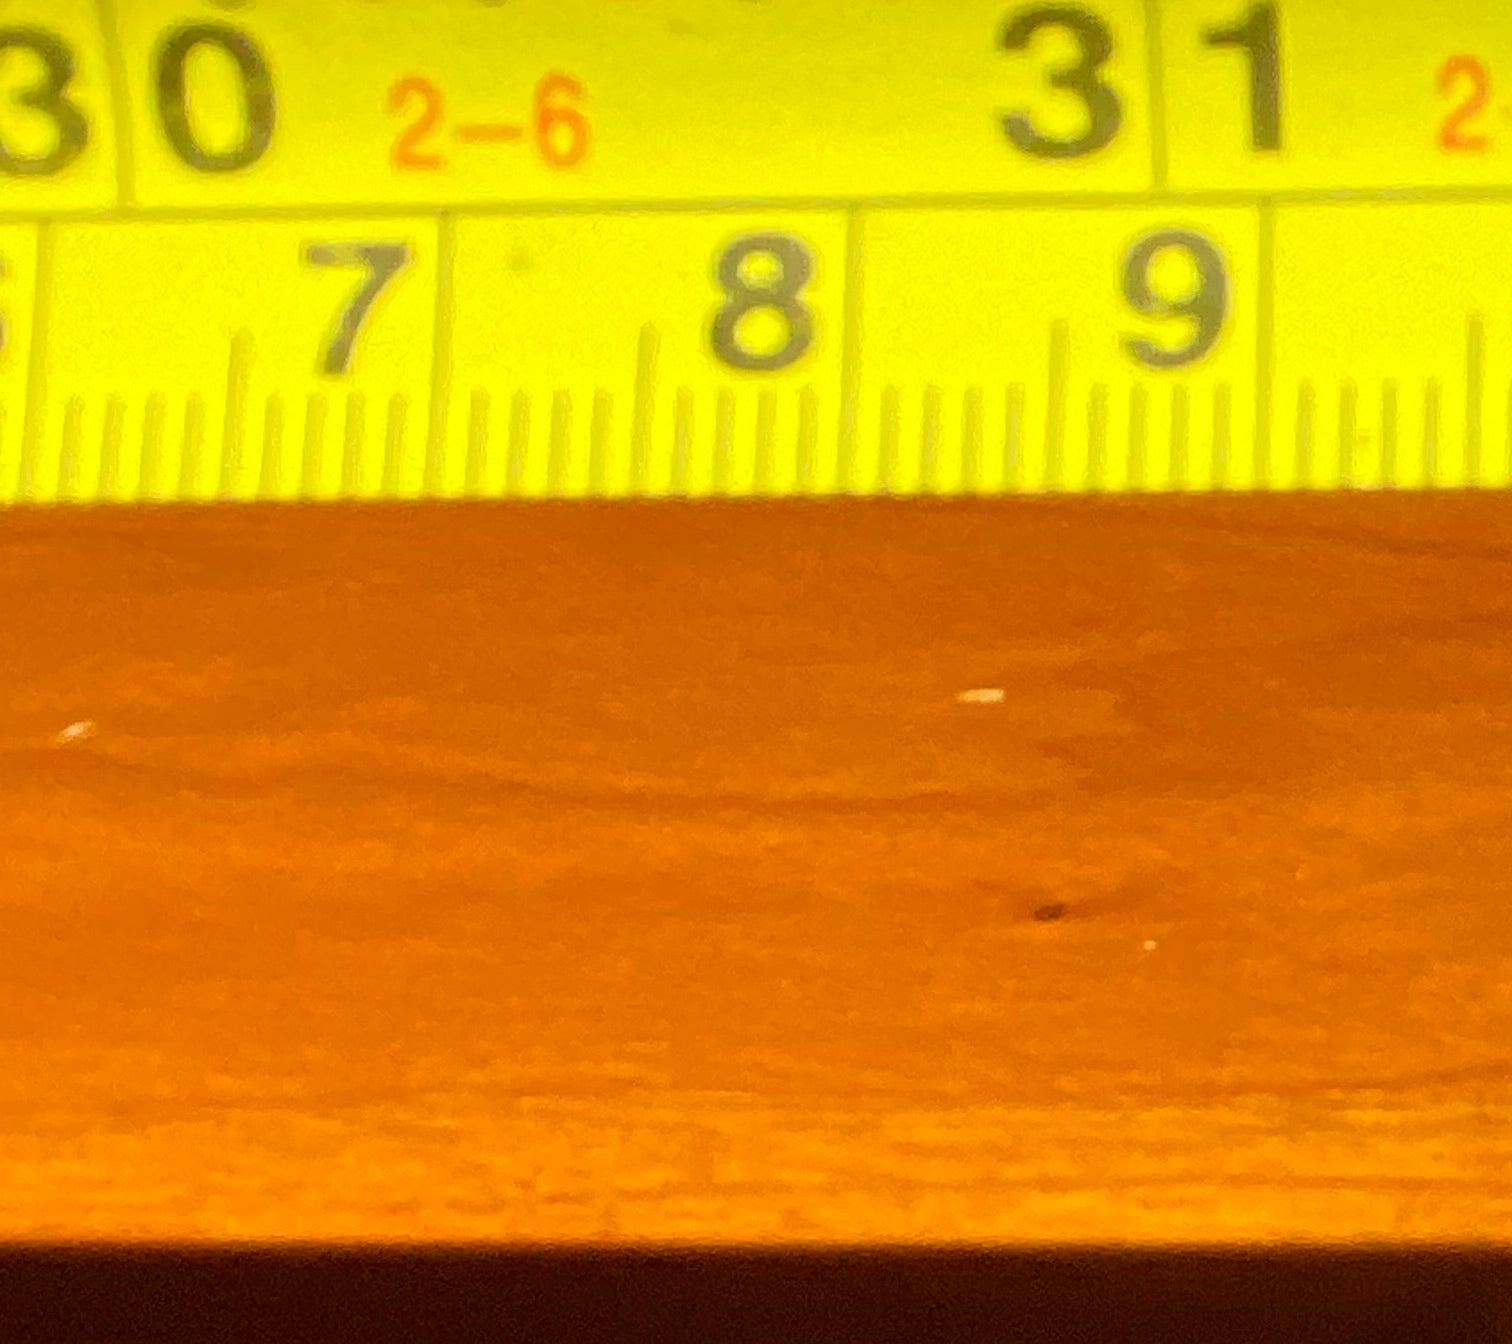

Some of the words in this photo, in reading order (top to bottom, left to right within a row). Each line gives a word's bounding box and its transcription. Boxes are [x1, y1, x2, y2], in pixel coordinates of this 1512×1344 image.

[299, 237, 416, 378] 7
[706, 230, 817, 373] 8
[1116, 226, 1230, 370] 9
